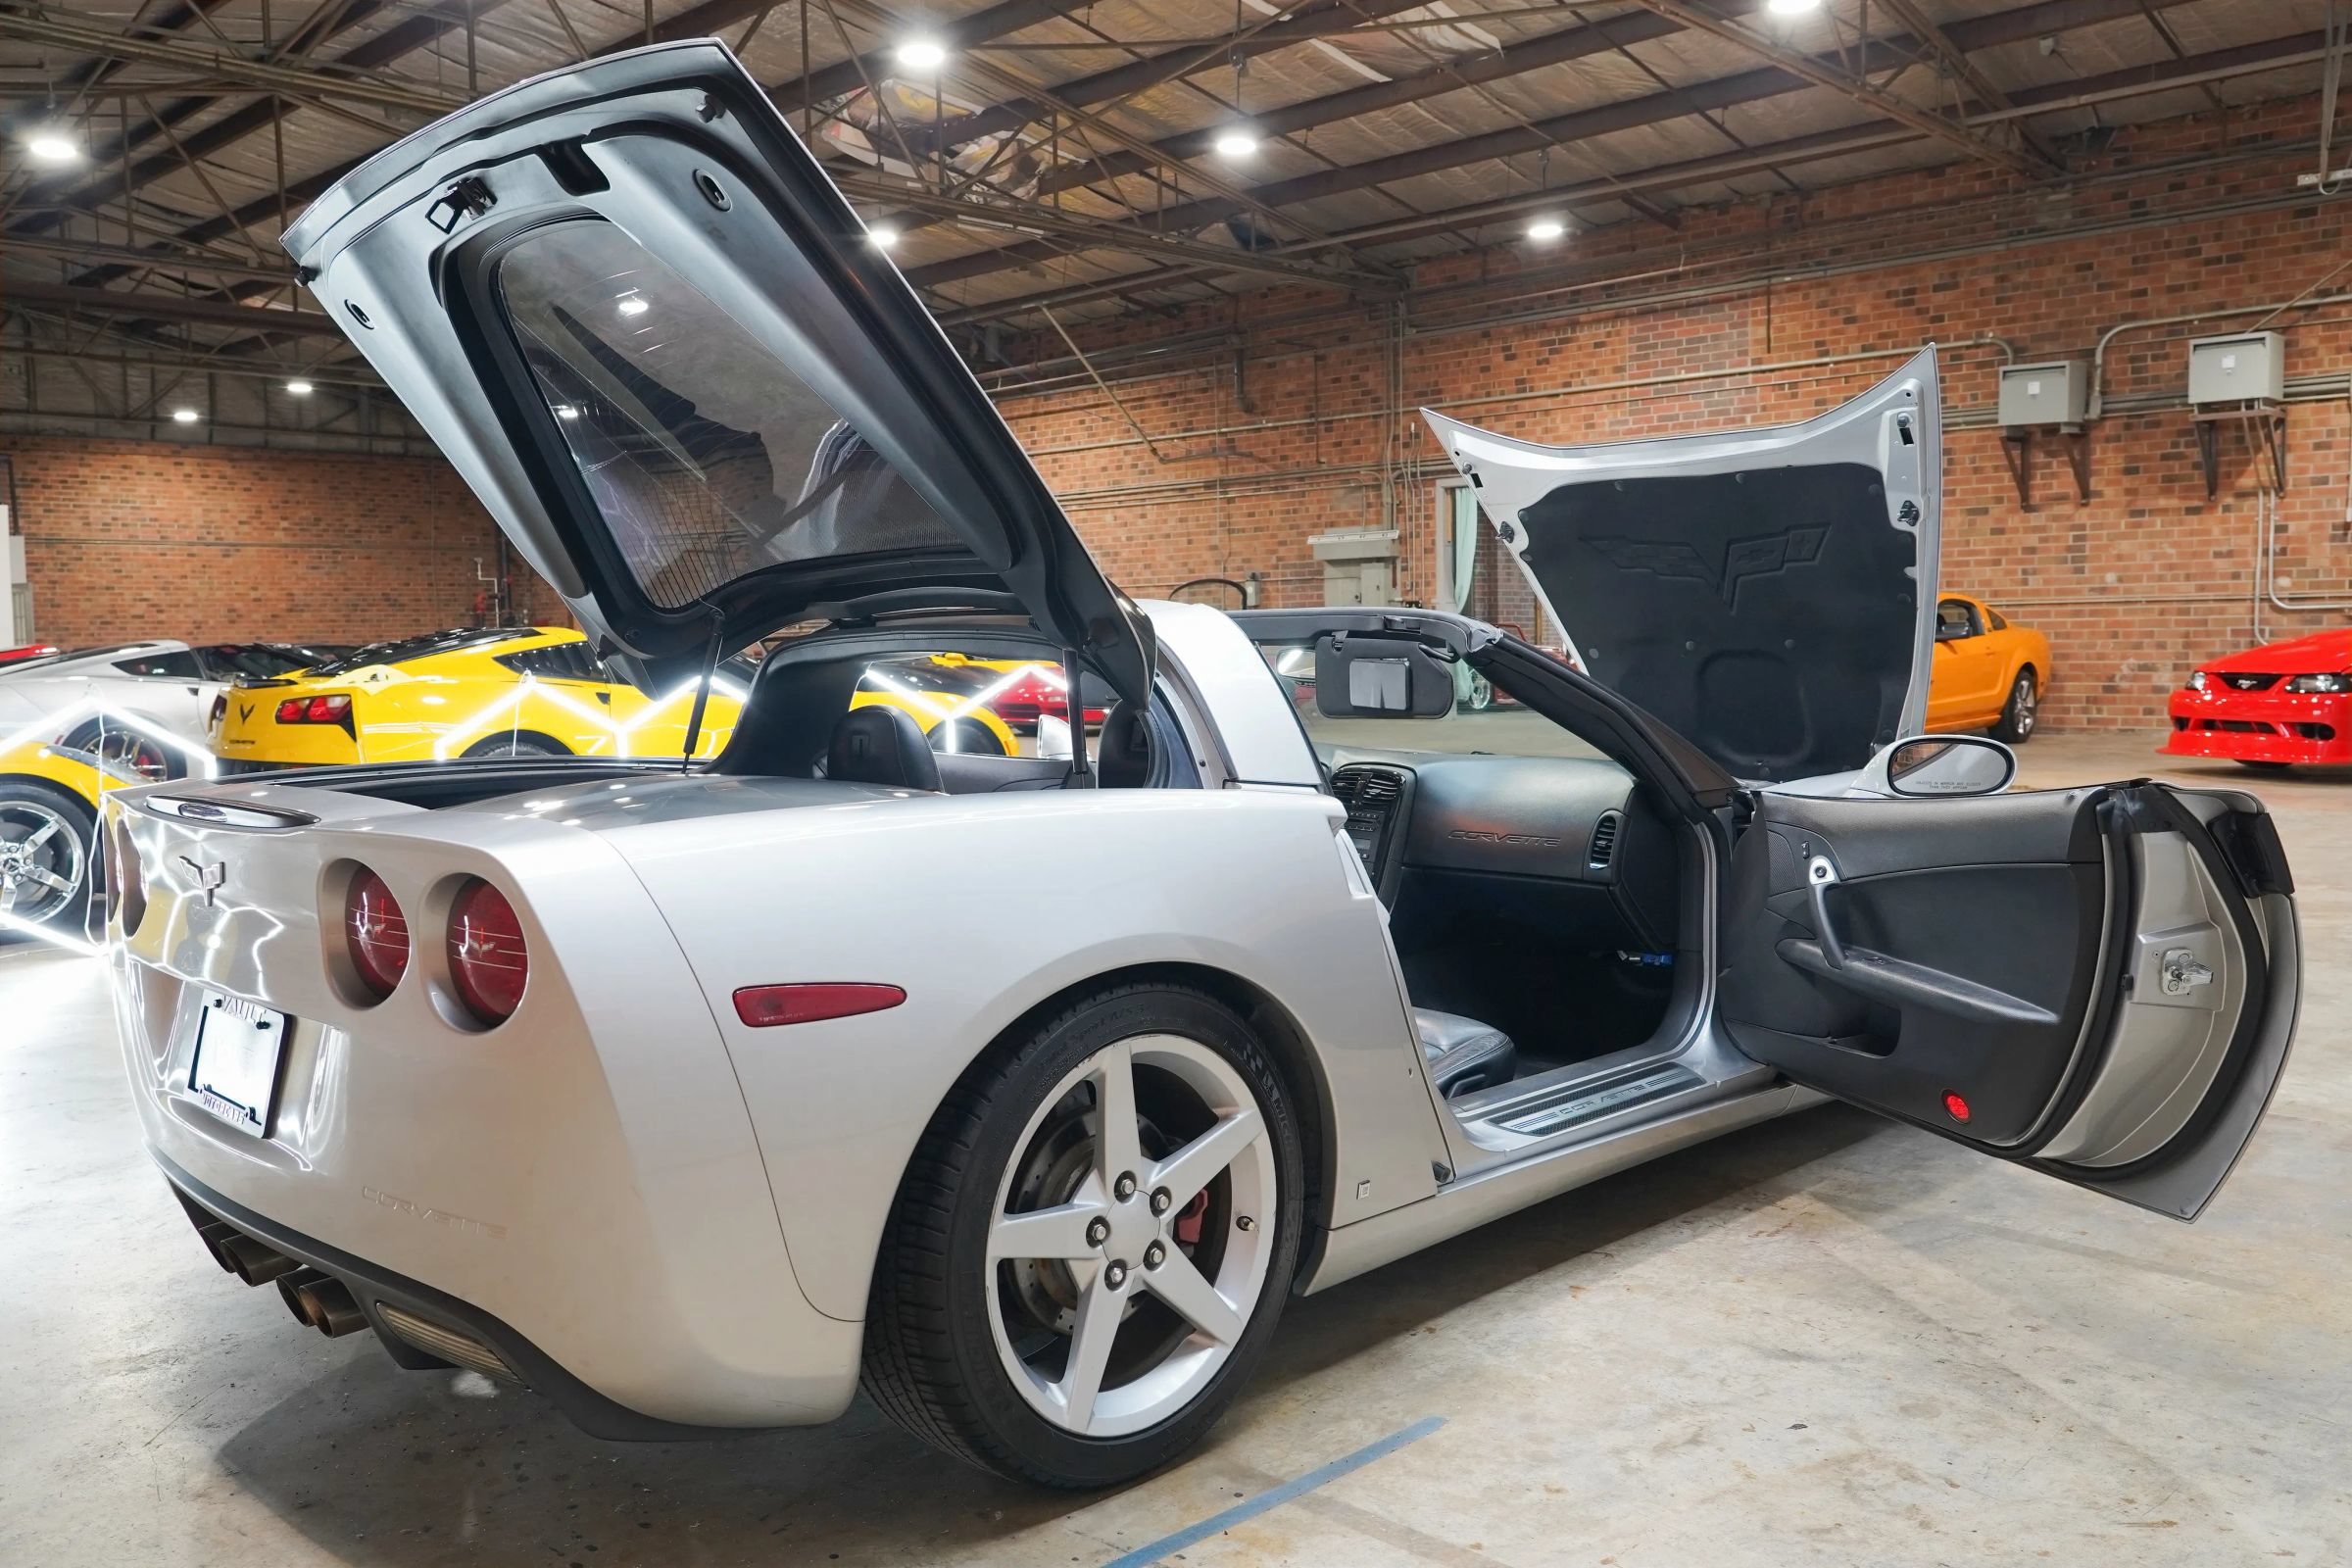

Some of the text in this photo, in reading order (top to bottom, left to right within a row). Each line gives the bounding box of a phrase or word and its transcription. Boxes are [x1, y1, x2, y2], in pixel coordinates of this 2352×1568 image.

[1448, 830, 1561, 848] CORVETTE
[223, 995, 268, 1024] VAULT
[362, 1185, 510, 1241] CORVETTE
